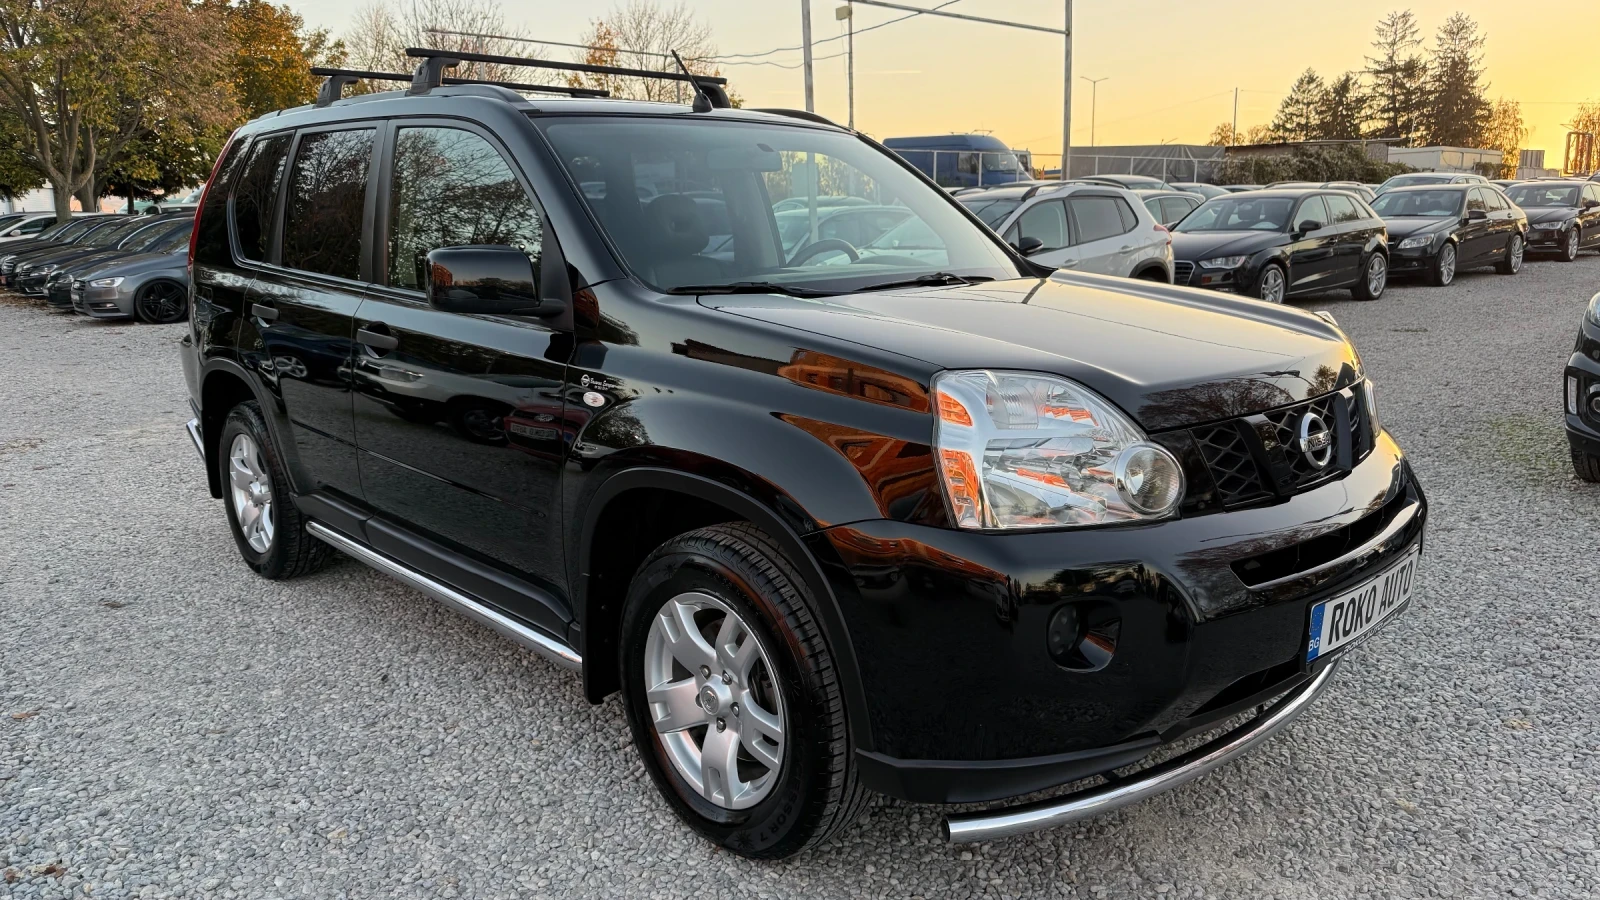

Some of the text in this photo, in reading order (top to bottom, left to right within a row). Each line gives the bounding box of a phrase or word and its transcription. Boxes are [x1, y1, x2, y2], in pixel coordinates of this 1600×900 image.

[1328, 585, 1377, 646] ROKO
[1378, 560, 1413, 615] AUTO
[1308, 636, 1320, 652] BG
